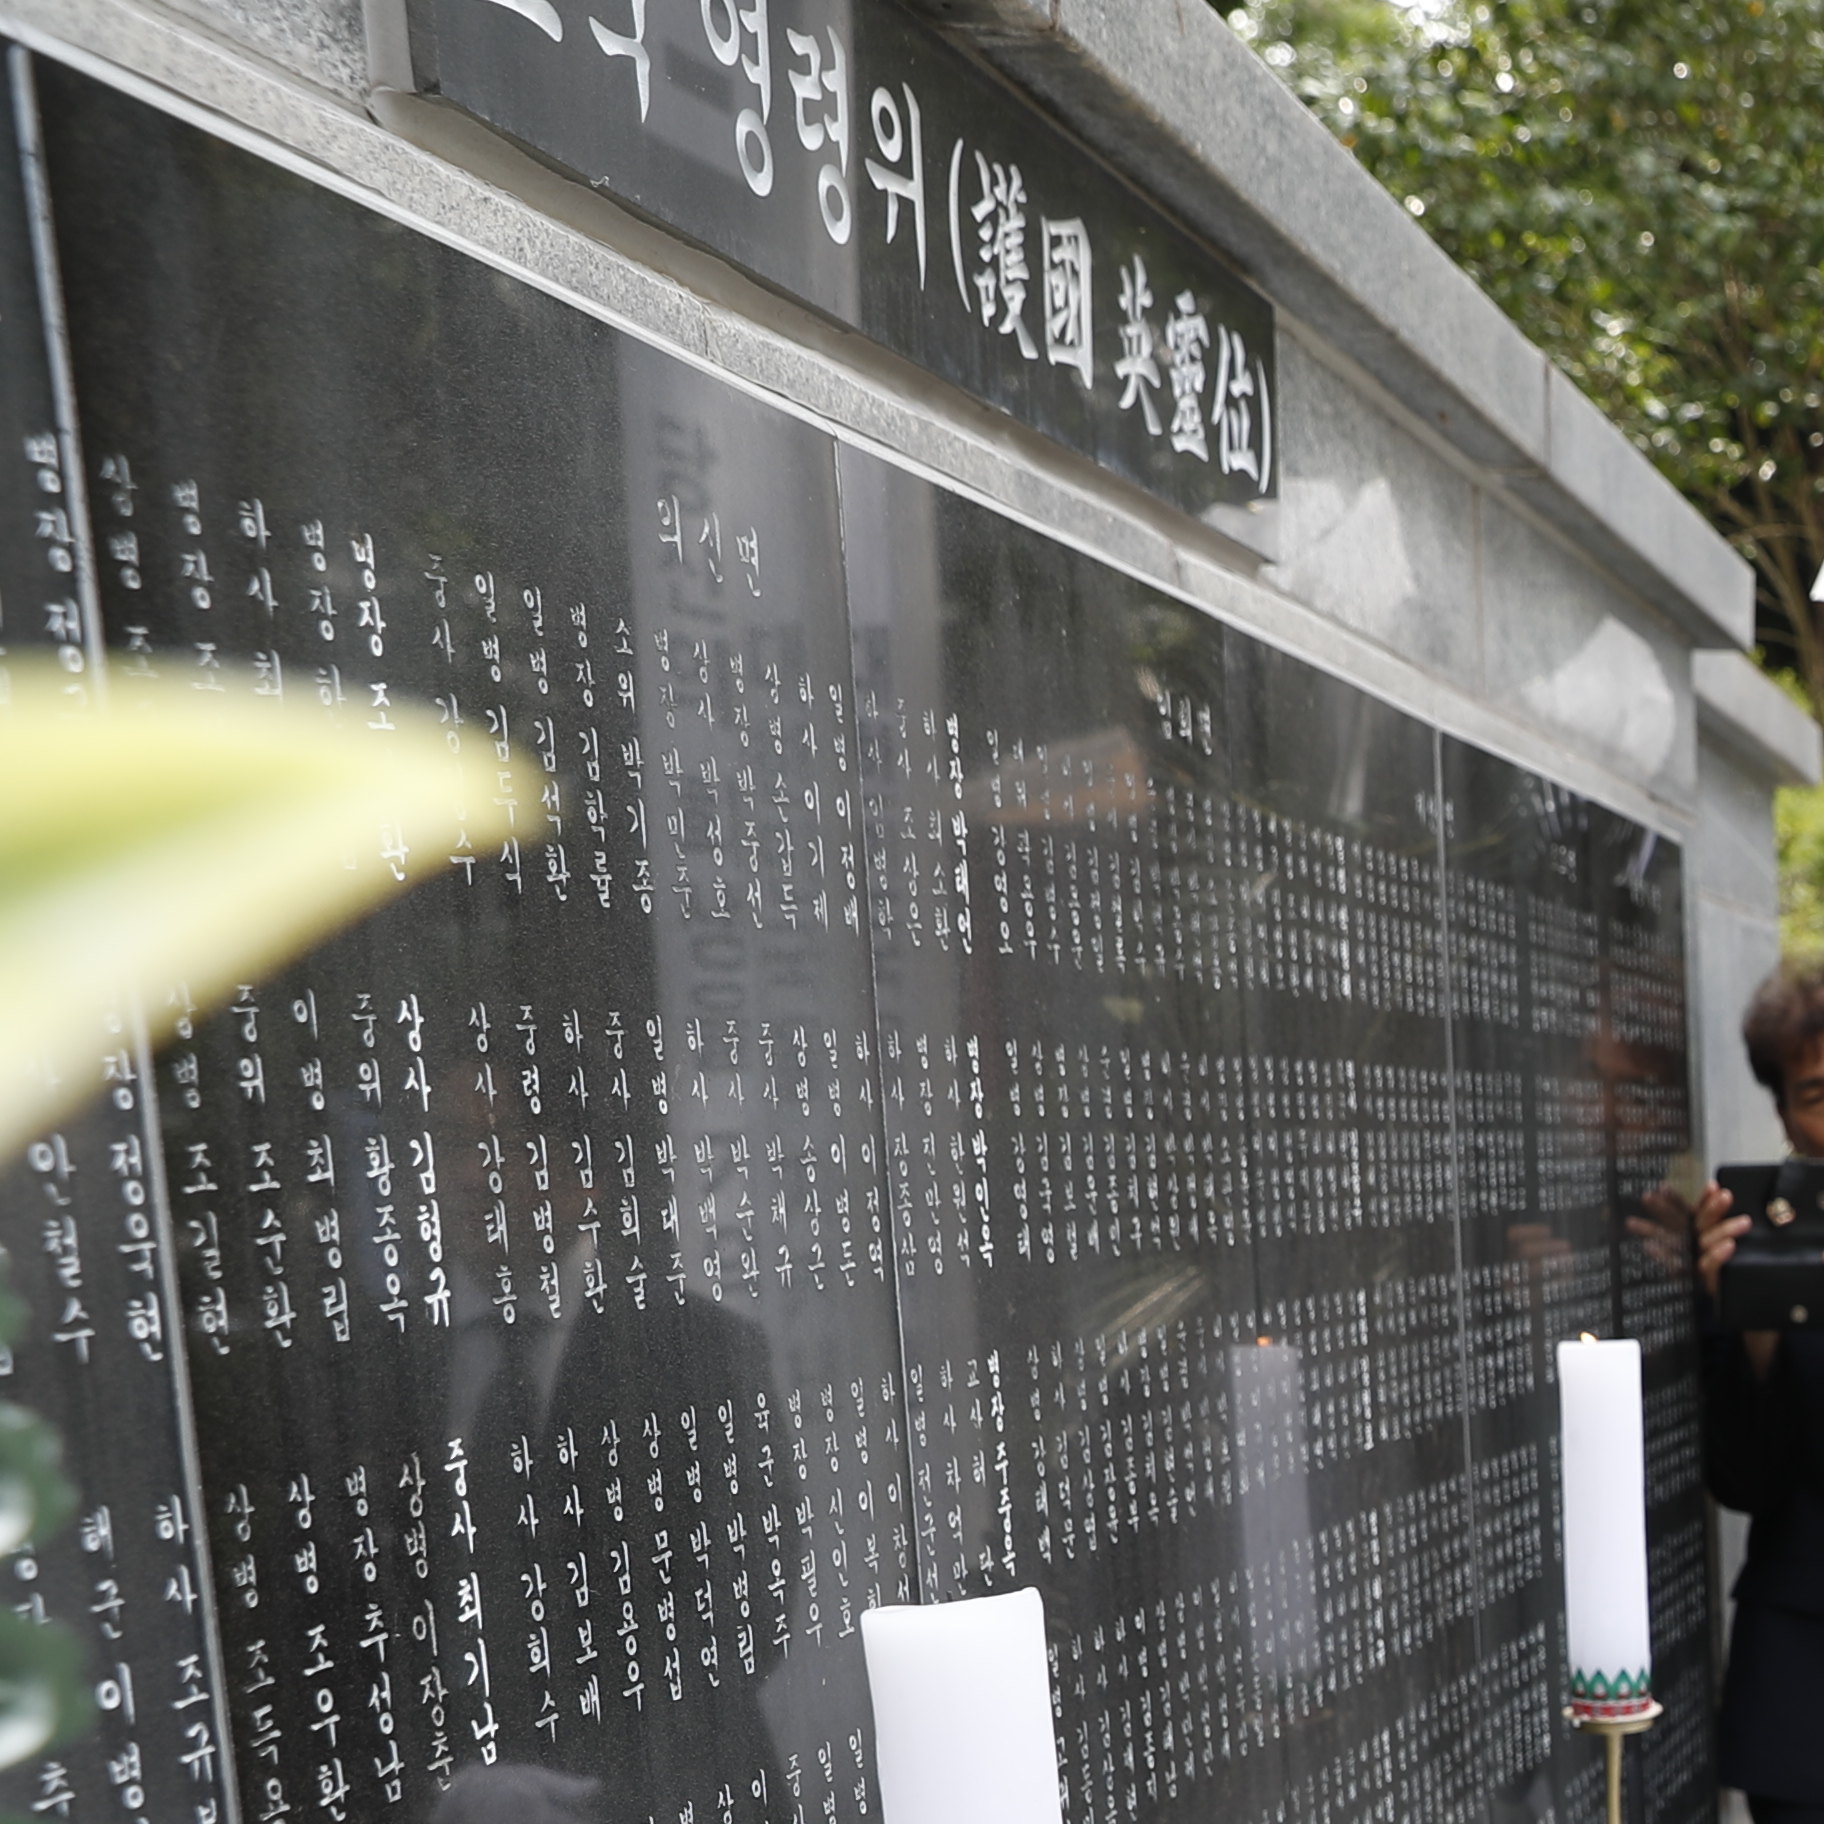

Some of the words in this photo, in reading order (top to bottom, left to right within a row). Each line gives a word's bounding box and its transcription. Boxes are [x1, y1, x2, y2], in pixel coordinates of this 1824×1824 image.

[522, 586, 549, 696] 일병
[615, 618, 636, 712] 소위
[653, 627, 676, 729] 병장
[693, 638, 716, 728] 상사
[729, 652, 750, 748] 병장
[798, 672, 818, 758] 하사
[828, 683, 847, 773] 일병
[533, 716, 572, 902] 김석환
[620, 736, 654, 914] 박기종
[661, 747, 693, 920] 박민준
[699, 755, 731, 919] 박성호
[735, 764, 764, 930] 박중선
[803, 780, 829, 932] 이기제
[835, 789, 860, 936] 이정배
[232, 985, 267, 1105] 중위
[292, 989, 326, 1112] 이병
[351, 993, 382, 1105] 중위
[396, 992, 433, 1112] 상사
[468, 1001, 498, 1106] 상사
[515, 1004, 542, 1115] 중령
[561, 1008, 590, 1109] 하사
[604, 1011, 632, 1110] 중사
[645, 1014, 669, 1115] 일병
[685, 1017, 709, 1107] 하사
[722, 1019, 745, 1106] 중사
[757, 1022, 780, 1110] 중사
[792, 1025, 811, 1117] 상병
[822, 1028, 842, 1118] 일병
[887, 1029, 906, 1111] 하사
[915, 1033, 934, 1117] 병장
[183, 1141, 231, 1356] 조길현
[247, 1141, 297, 1349] 조순환
[306, 1133, 351, 1343] 최병립
[408, 1130, 452, 1328] 김형규
[477, 1134, 518, 1325] 강태흥
[525, 1134, 562, 1320] 김병철
[571, 1133, 608, 1315] 김수환
[614, 1133, 648, 1311] 김희술
[654, 1133, 688, 1307] 박대준
[693, 1134, 723, 1303] 박백영
[730, 1134, 761, 1299] 박순완
[765, 1134, 793, 1288] 박채규
[800, 1134, 826, 1291] 송상근
[830, 1132, 857, 1288] 이병돈
[893, 1131, 918, 1277] 장종삼
[922, 1131, 944, 1276] 진만영
[510, 1434, 540, 1539] 하사
[556, 1426, 585, 1528] 하사
[600, 1418, 624, 1523] 상병
[642, 1411, 665, 1513] 상병
[680, 1404, 703, 1504] 일병
[753, 1392, 775, 1489] 육군
[787, 1388, 808, 1481] 병장
[819, 1383, 840, 1473] 병장
[154, 1493, 198, 1615] 하사
[288, 1473, 320, 1595] 상병
[345, 1464, 380, 1583] 병장
[398, 1452, 429, 1580] 상병
[443, 1436, 478, 1554] 중사
[82, 1504, 125, 1640] 해군
[650, 1529, 683, 1702] 문병섭
[689, 1520, 721, 1688] 박덕연
[794, 1495, 823, 1647] 박필우
[828, 1487, 856, 1639] 신인호
[457, 1571, 500, 1766] 최기남
[520, 1562, 560, 1743] 강희수
[566, 1551, 602, 1723] 김보배
[609, 1540, 645, 1712] 김용우
[302, 1623, 351, 1823] 조우환
[358, 1602, 405, 1804] 추성남
[848, 1727, 868, 1815] 일병
